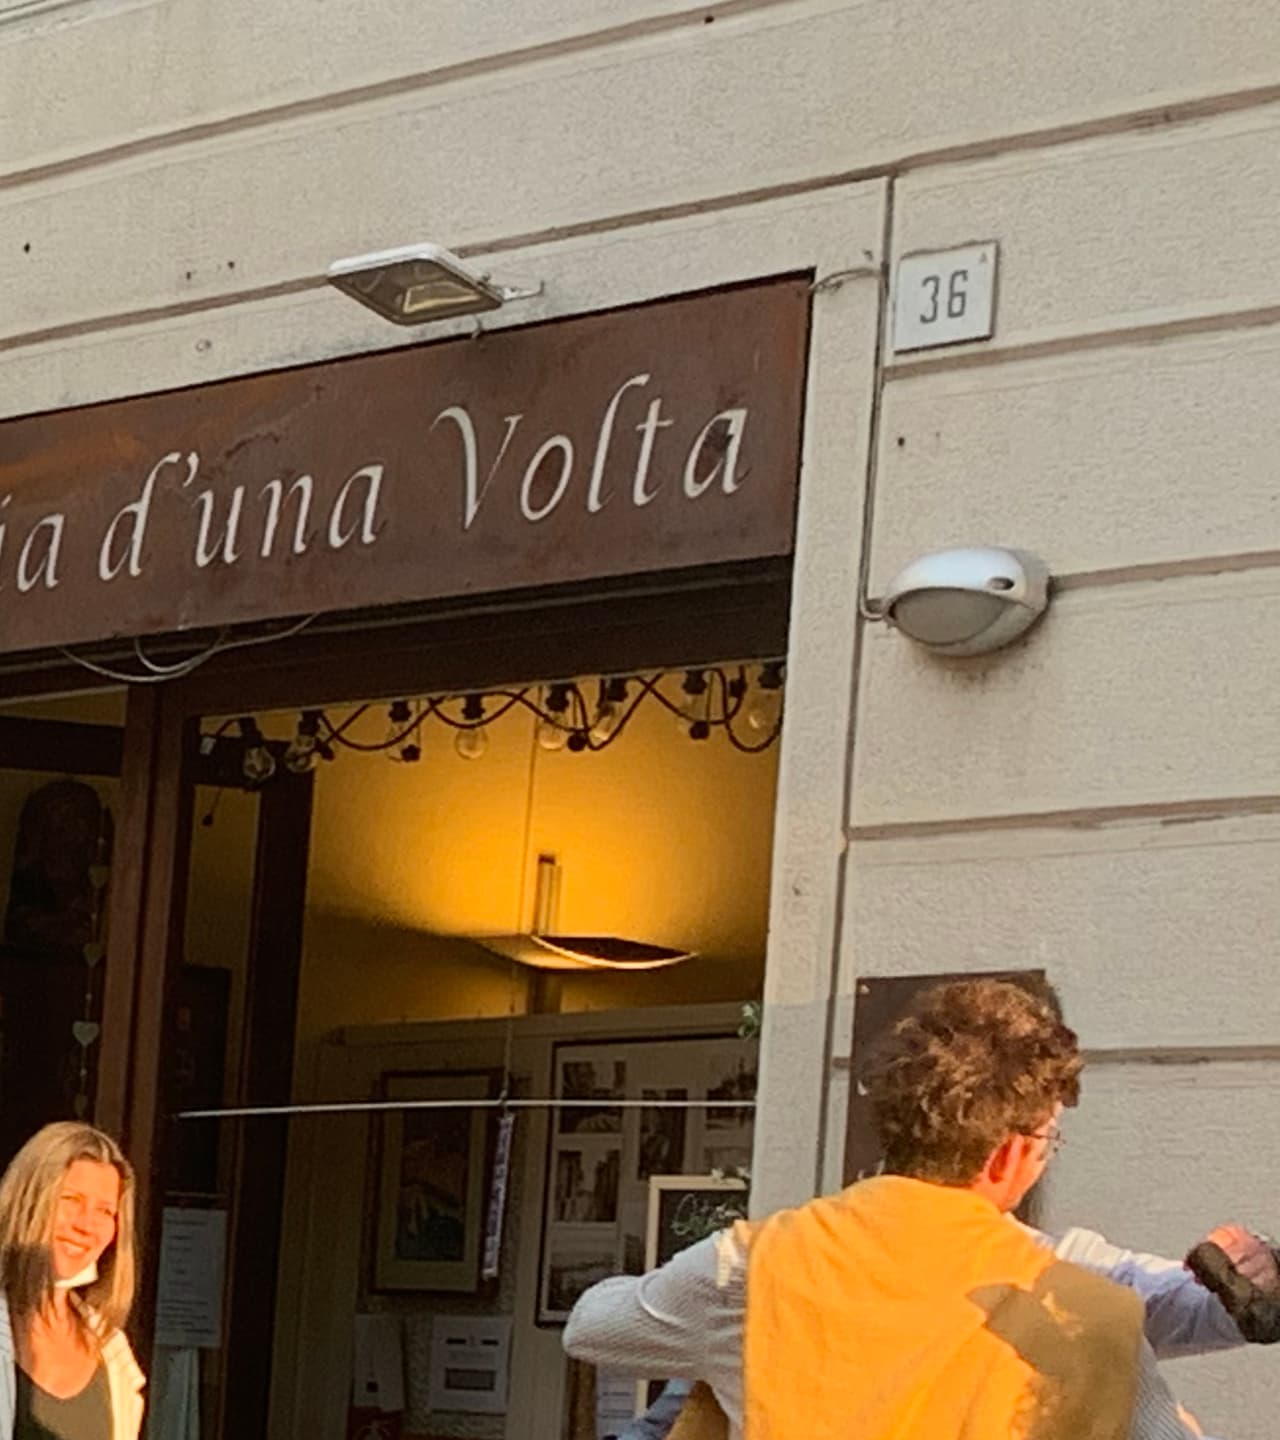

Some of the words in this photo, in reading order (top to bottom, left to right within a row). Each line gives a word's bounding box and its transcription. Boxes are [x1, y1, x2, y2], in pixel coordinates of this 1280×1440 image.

[919, 269, 969, 325] 36
[96, 450, 387, 582] d'una
[428, 372, 753, 532] Volta
